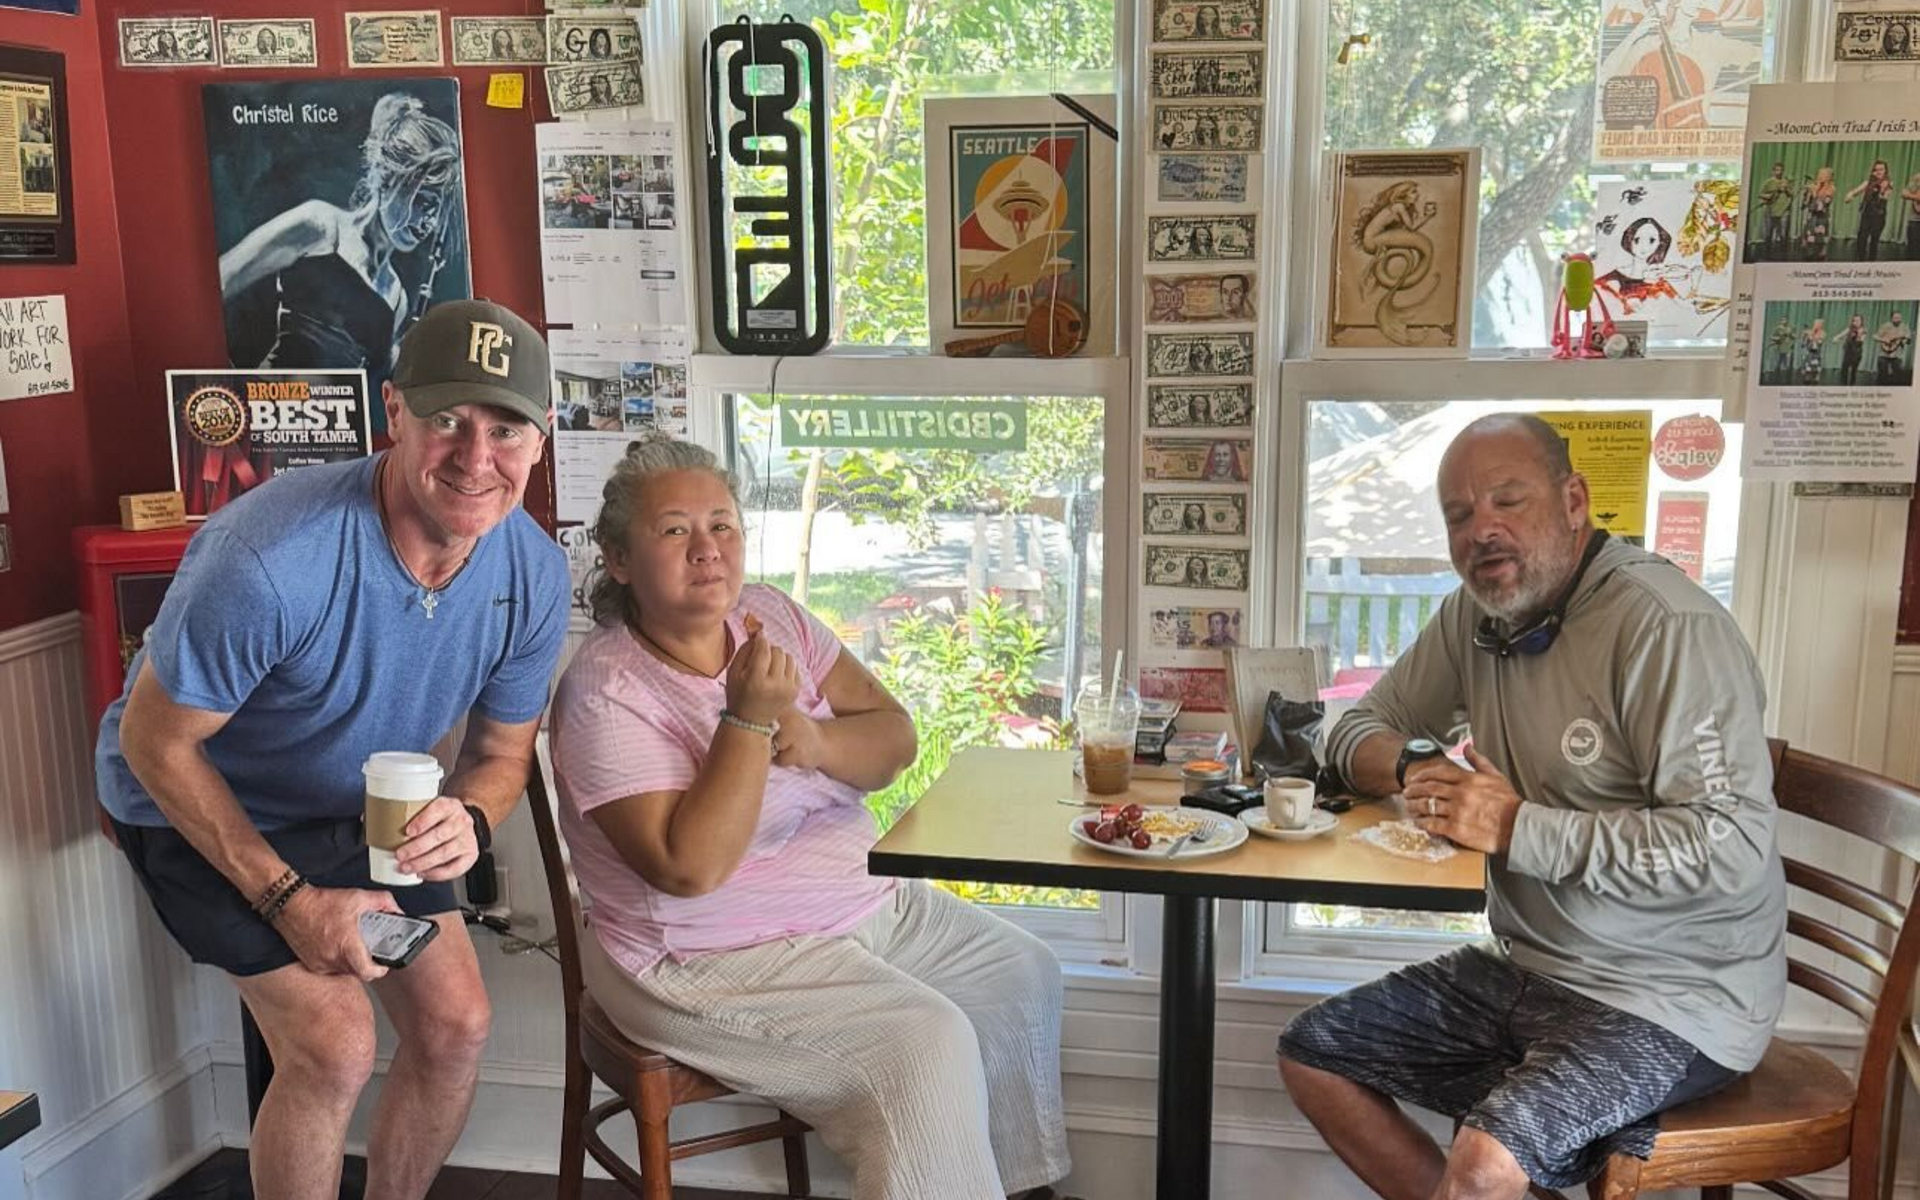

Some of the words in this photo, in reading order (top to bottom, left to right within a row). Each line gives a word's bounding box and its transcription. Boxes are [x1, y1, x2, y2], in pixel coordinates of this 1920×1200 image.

[232, 103, 294, 125] Christel
[301, 104, 339, 123] Rice
[1842, 119, 1876, 133] Trad
[1876, 119, 1906, 133] Irish
[962, 137, 1038, 155] SEATTLE
[20, 300, 48, 323] ART
[36, 325, 64, 346] FOR
[247, 382, 310, 400] BRONZE
[309, 385, 354, 396] WINNER
[201, 413, 232, 428] 2014
[248, 399, 356, 431] BEST
[1578, 420, 1645, 430] EXPERIENCE
[251, 433, 262, 442] OF
[262, 430, 310, 443] SOUTH
[311, 430, 358, 443] TAMPA
